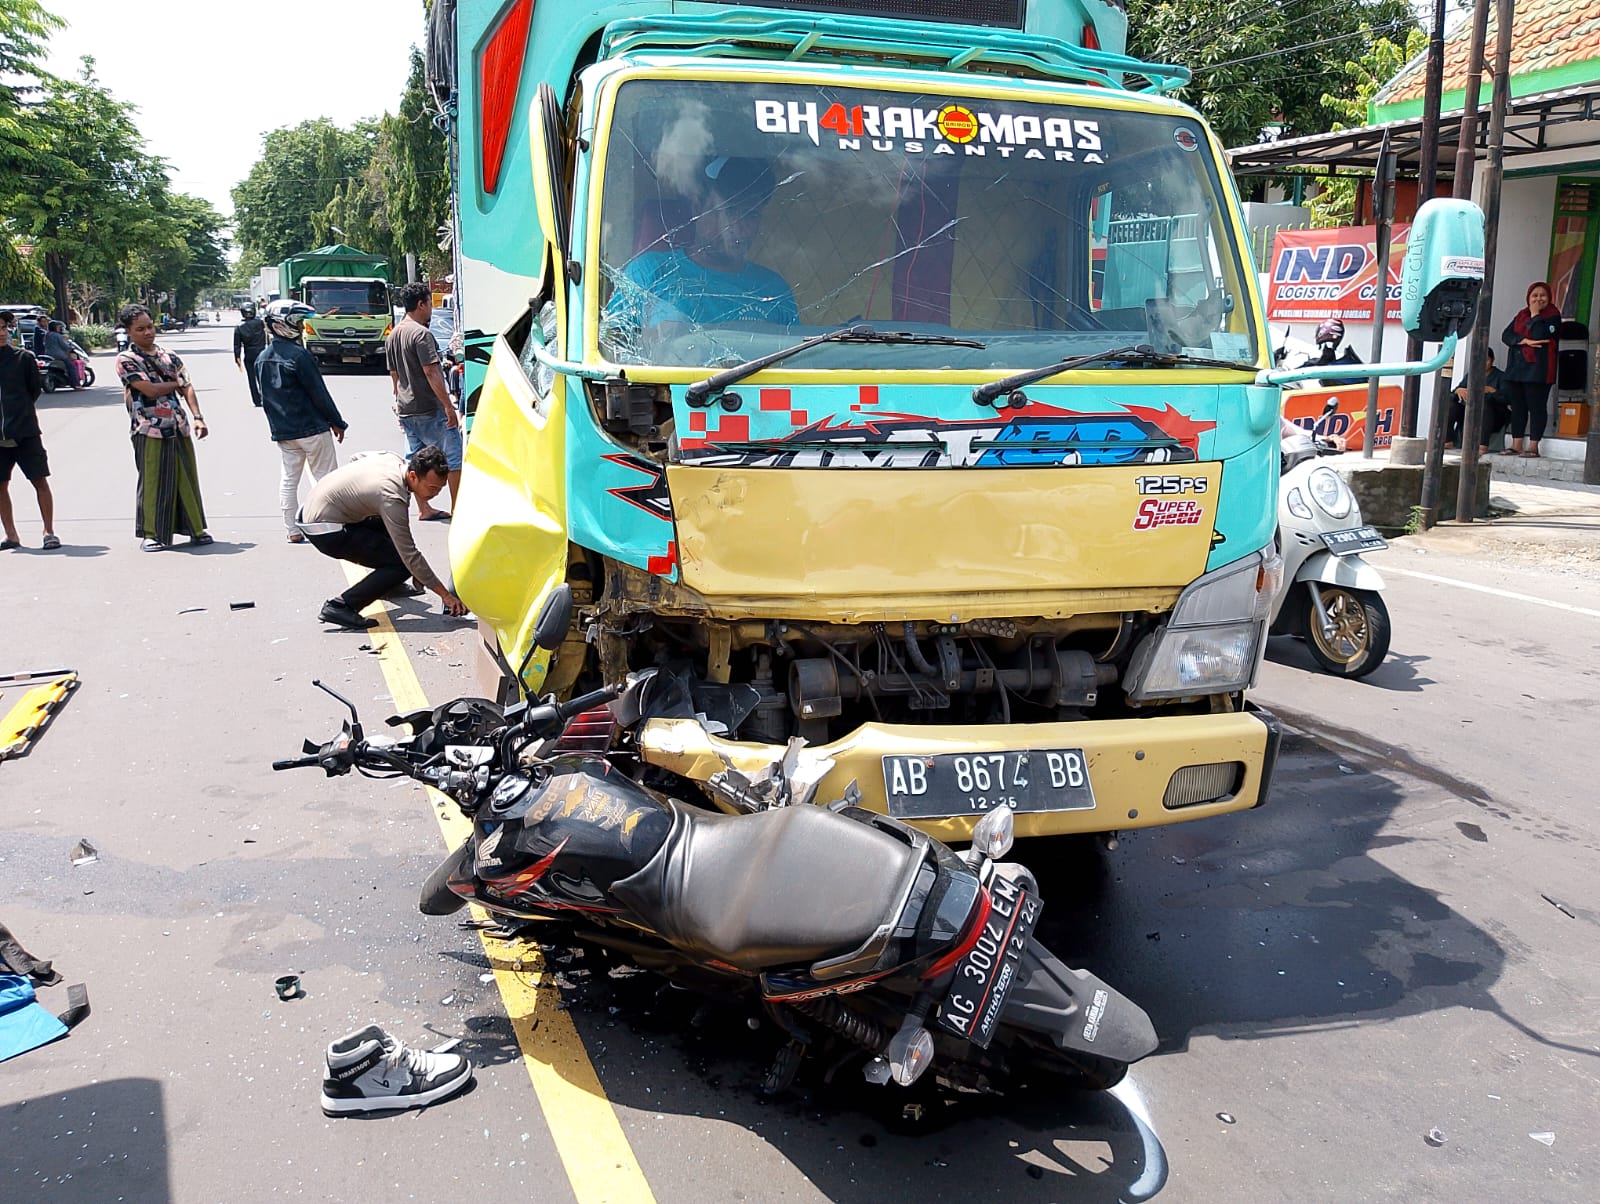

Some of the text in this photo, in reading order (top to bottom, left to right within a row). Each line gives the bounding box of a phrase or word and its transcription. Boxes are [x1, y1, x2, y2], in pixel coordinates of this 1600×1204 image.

[838, 138, 1105, 164] NUSANTARA
[1276, 284, 1402, 300] LOGISTIC CARG
[1135, 475, 1207, 495] 125PS
[891, 758, 928, 796] AB
[1046, 753, 1085, 788] BB
[477, 857, 503, 868] HONDA
[946, 877, 1021, 1032] AG 3002 EM
